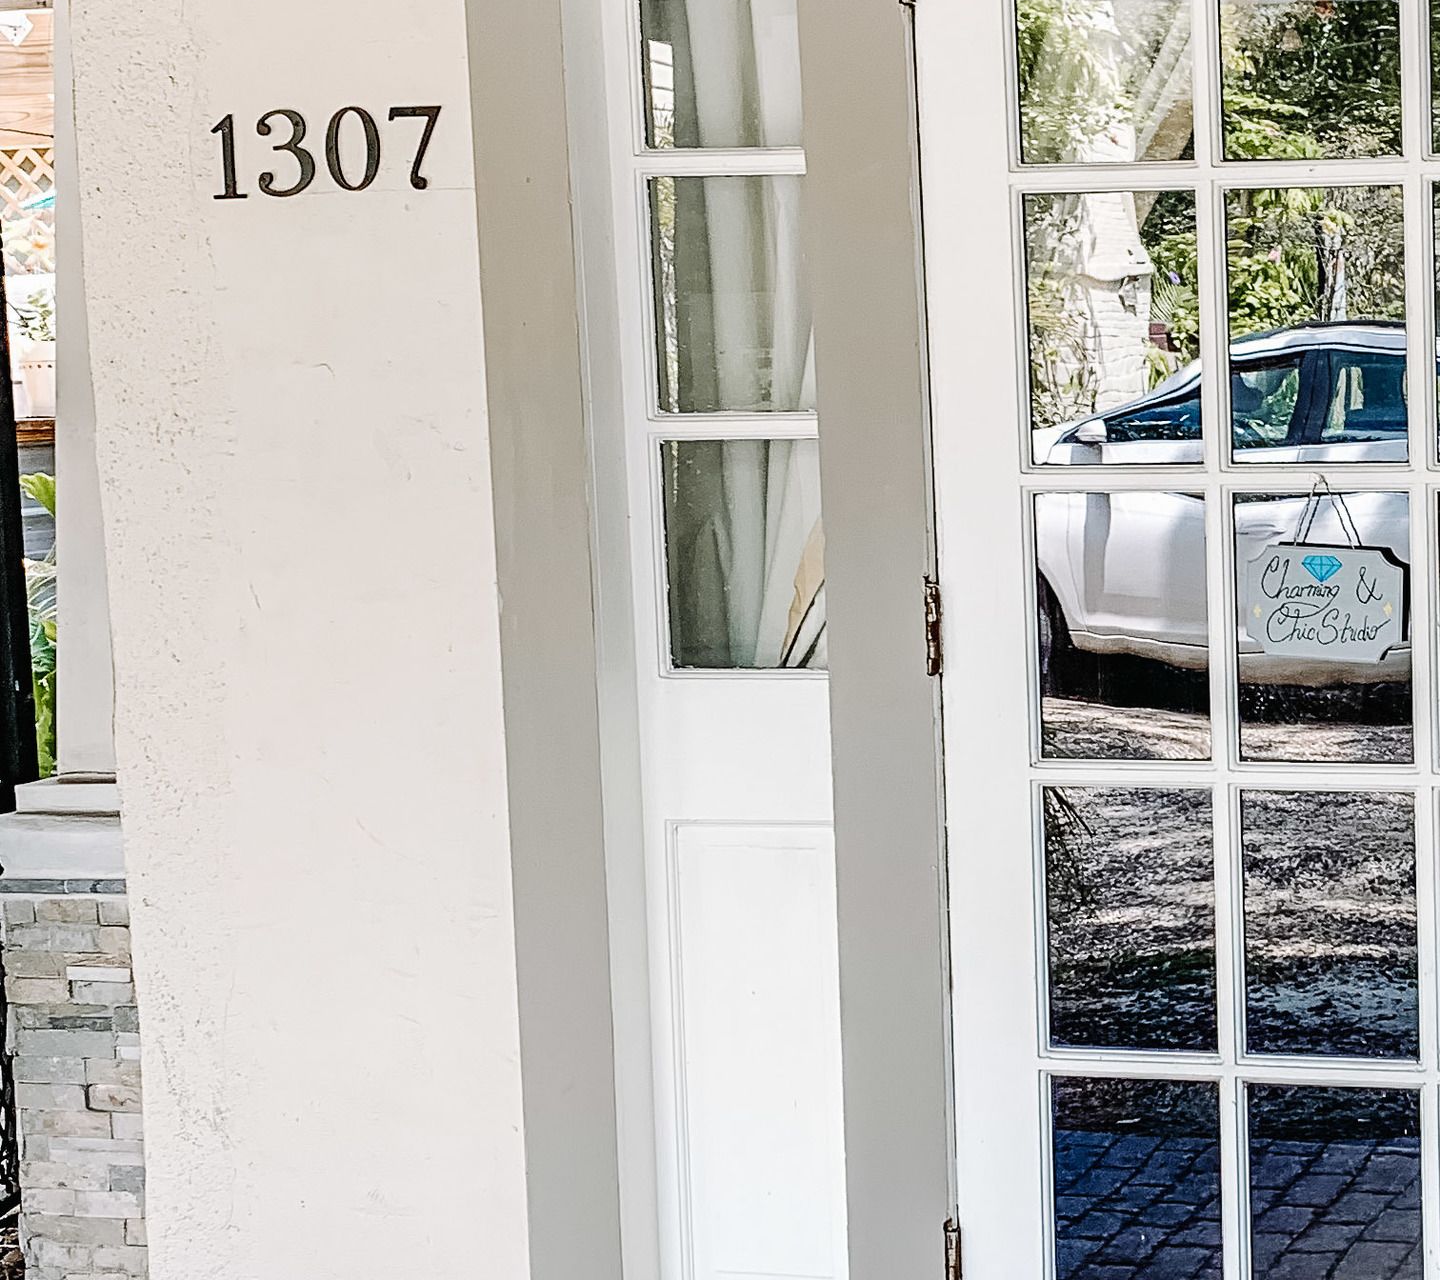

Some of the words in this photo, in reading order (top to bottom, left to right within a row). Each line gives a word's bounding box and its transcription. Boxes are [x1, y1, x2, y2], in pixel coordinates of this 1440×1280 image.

[210, 105, 442, 200] 1307
[1261, 555, 1341, 618] Charming
[1356, 566, 1383, 604] &
[1266, 603, 1319, 643] Chic
[1316, 608, 1391, 645] Studio
